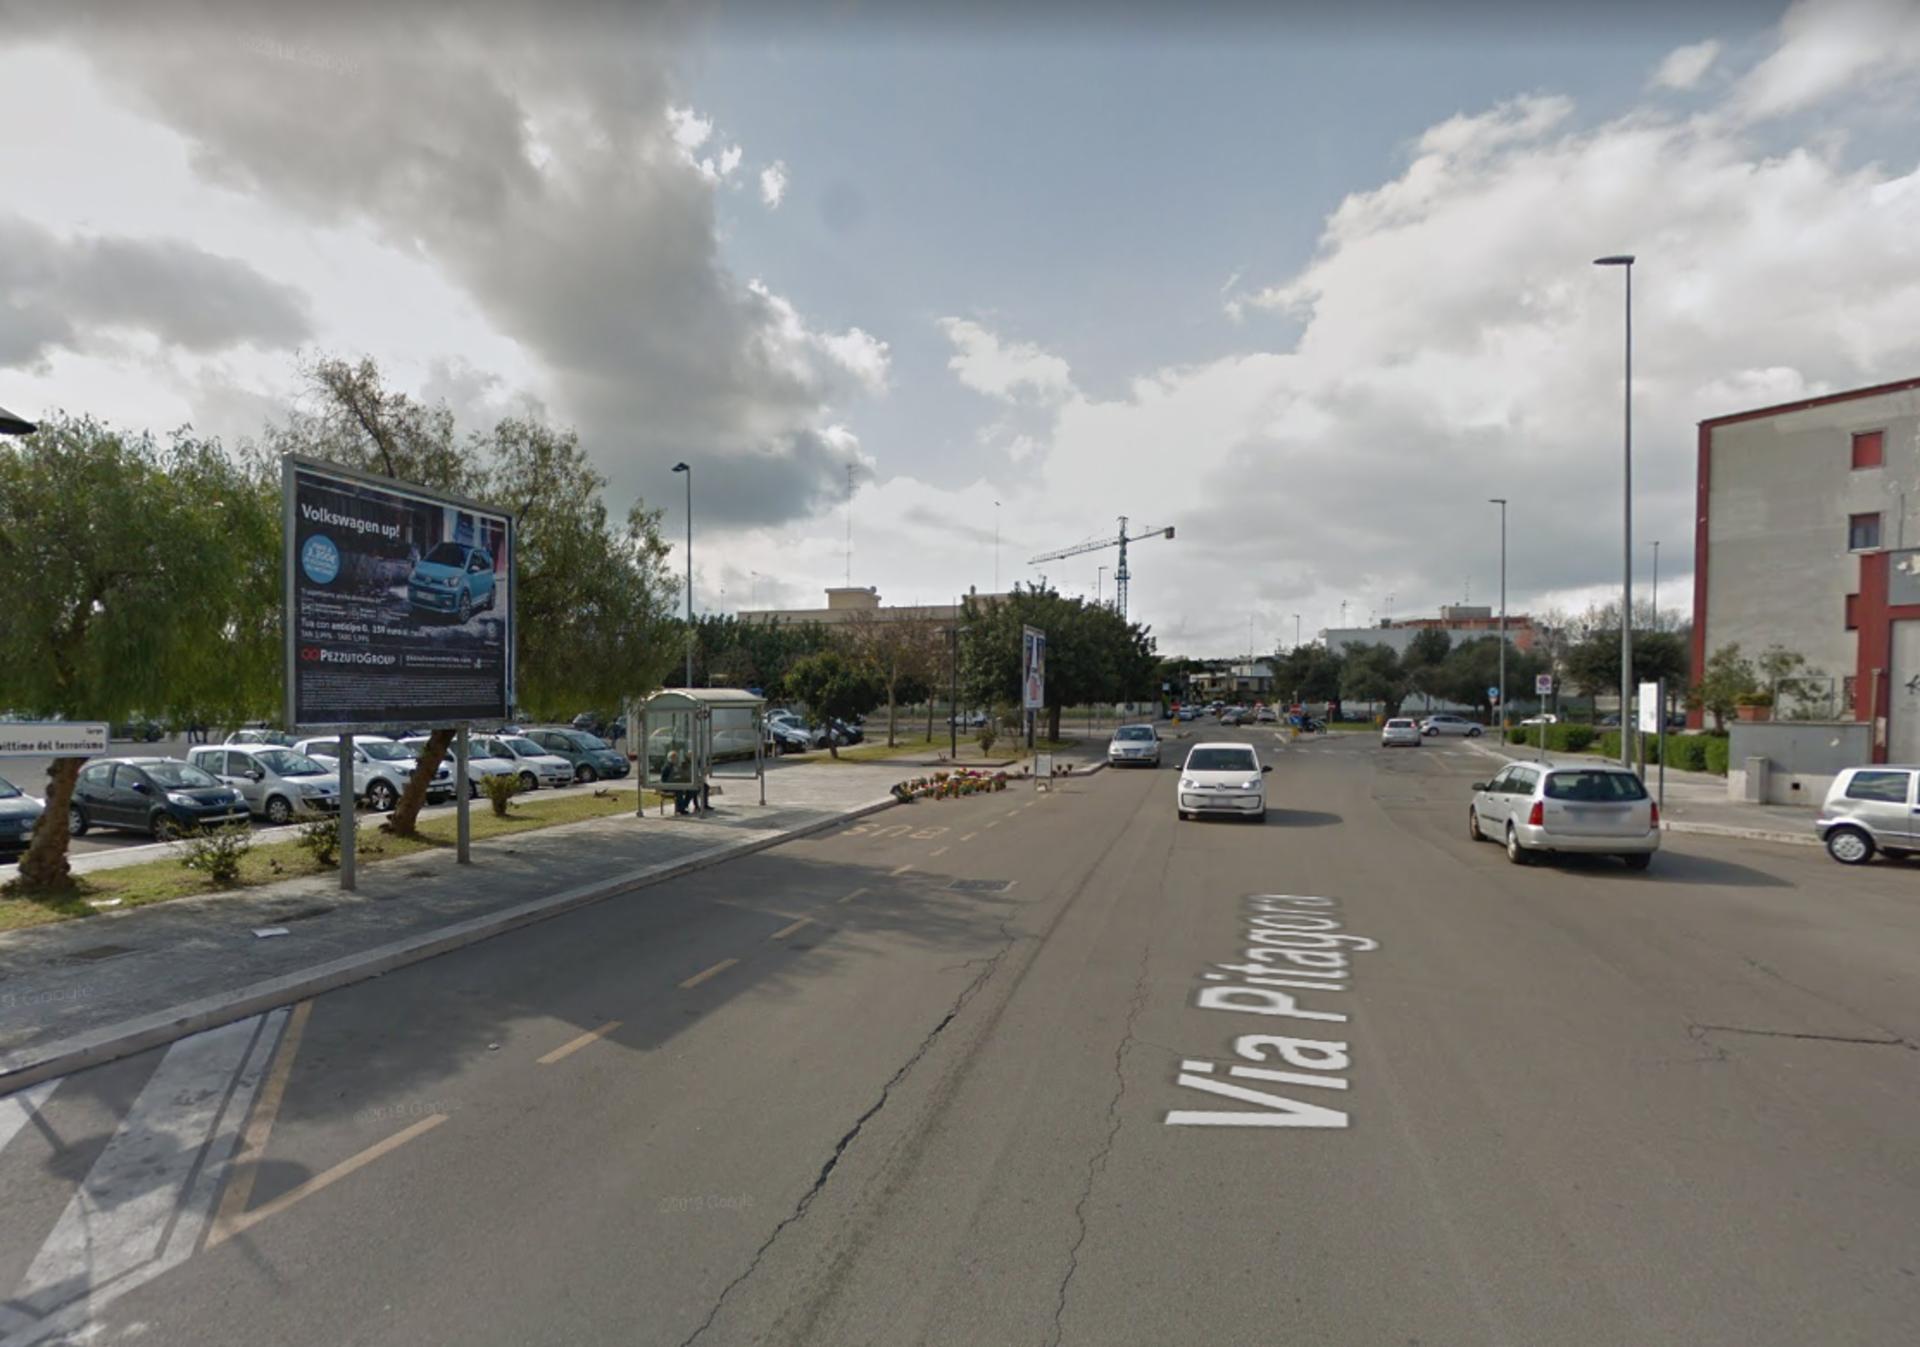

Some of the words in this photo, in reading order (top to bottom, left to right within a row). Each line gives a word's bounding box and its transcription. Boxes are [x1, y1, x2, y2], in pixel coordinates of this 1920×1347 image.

[301, 503, 379, 534] Volkswagen
[381, 524, 400, 539] up!
[37, 740, 52, 751] del
[55, 740, 104, 751] terrorismo
